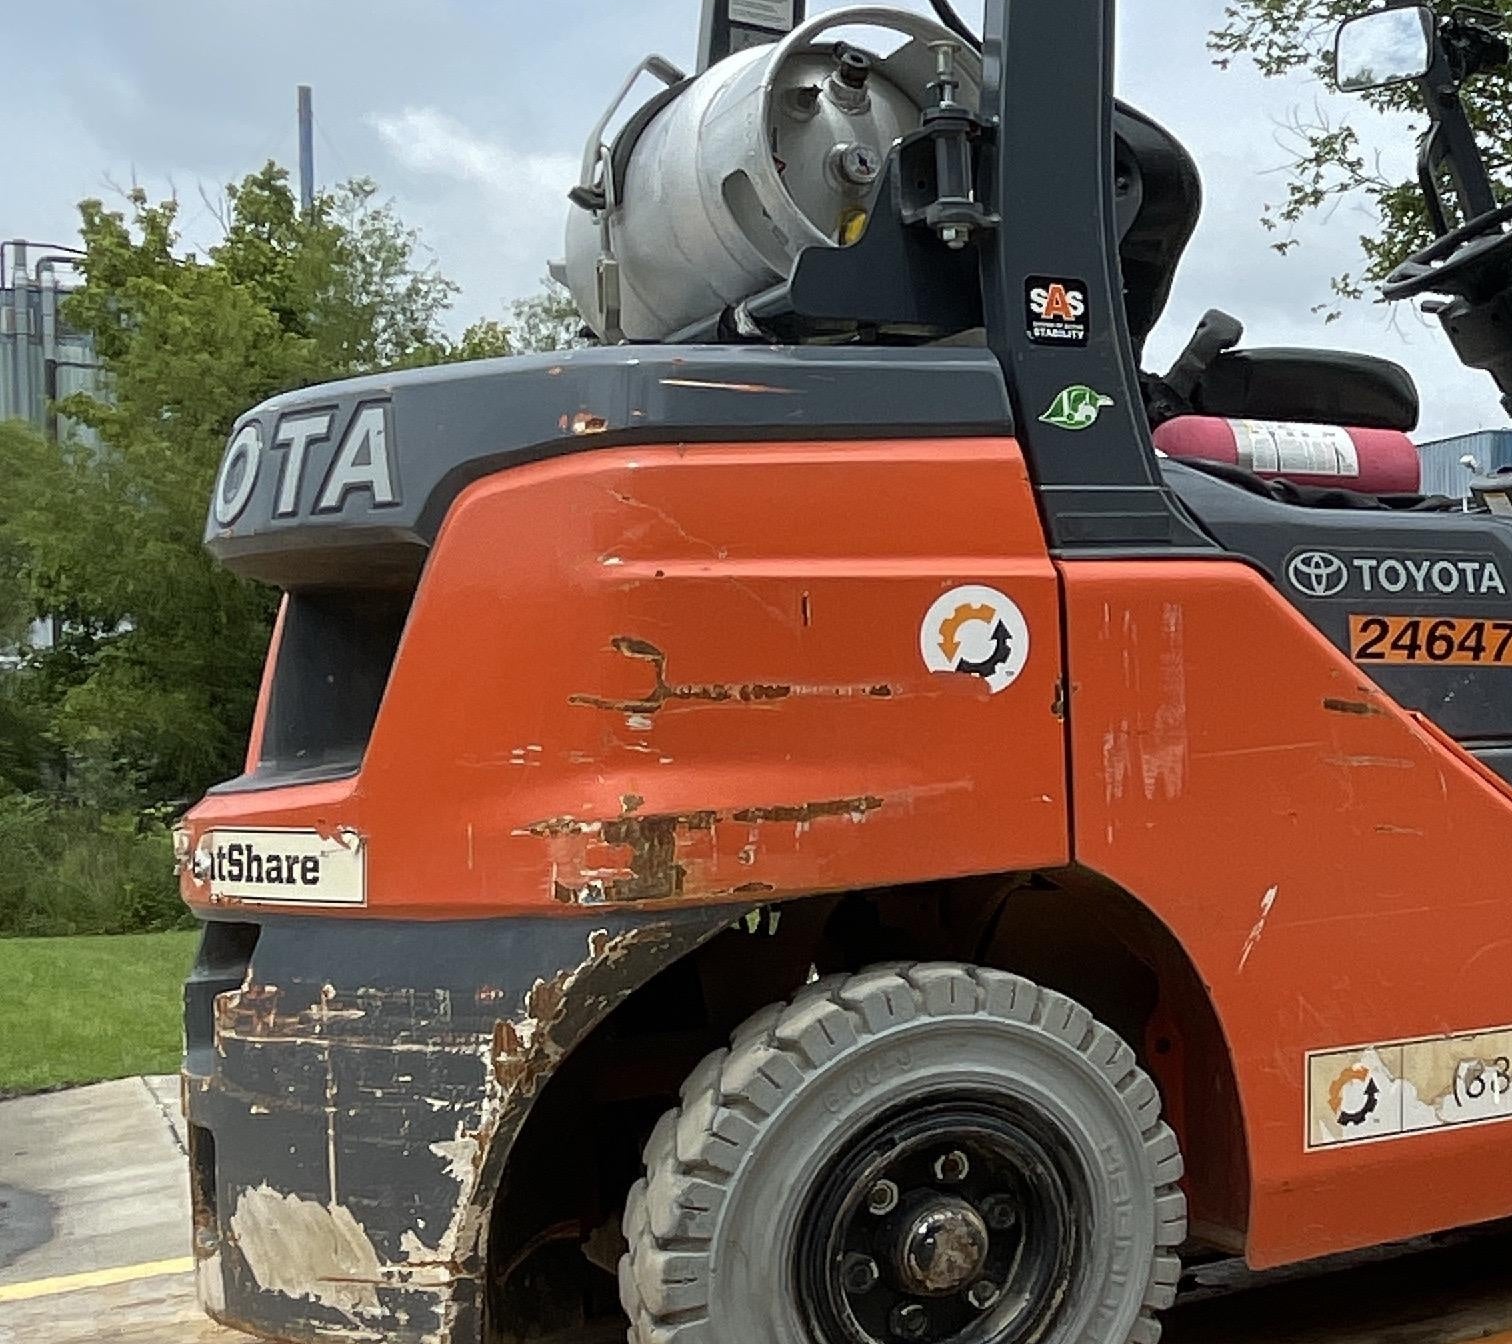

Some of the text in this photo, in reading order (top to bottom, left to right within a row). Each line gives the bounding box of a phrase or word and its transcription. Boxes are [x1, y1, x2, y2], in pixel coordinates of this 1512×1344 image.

[1030, 283, 1085, 321] SAS
[214, 399, 396, 525] OTA
[1353, 558, 1506, 595] TOYOTA
